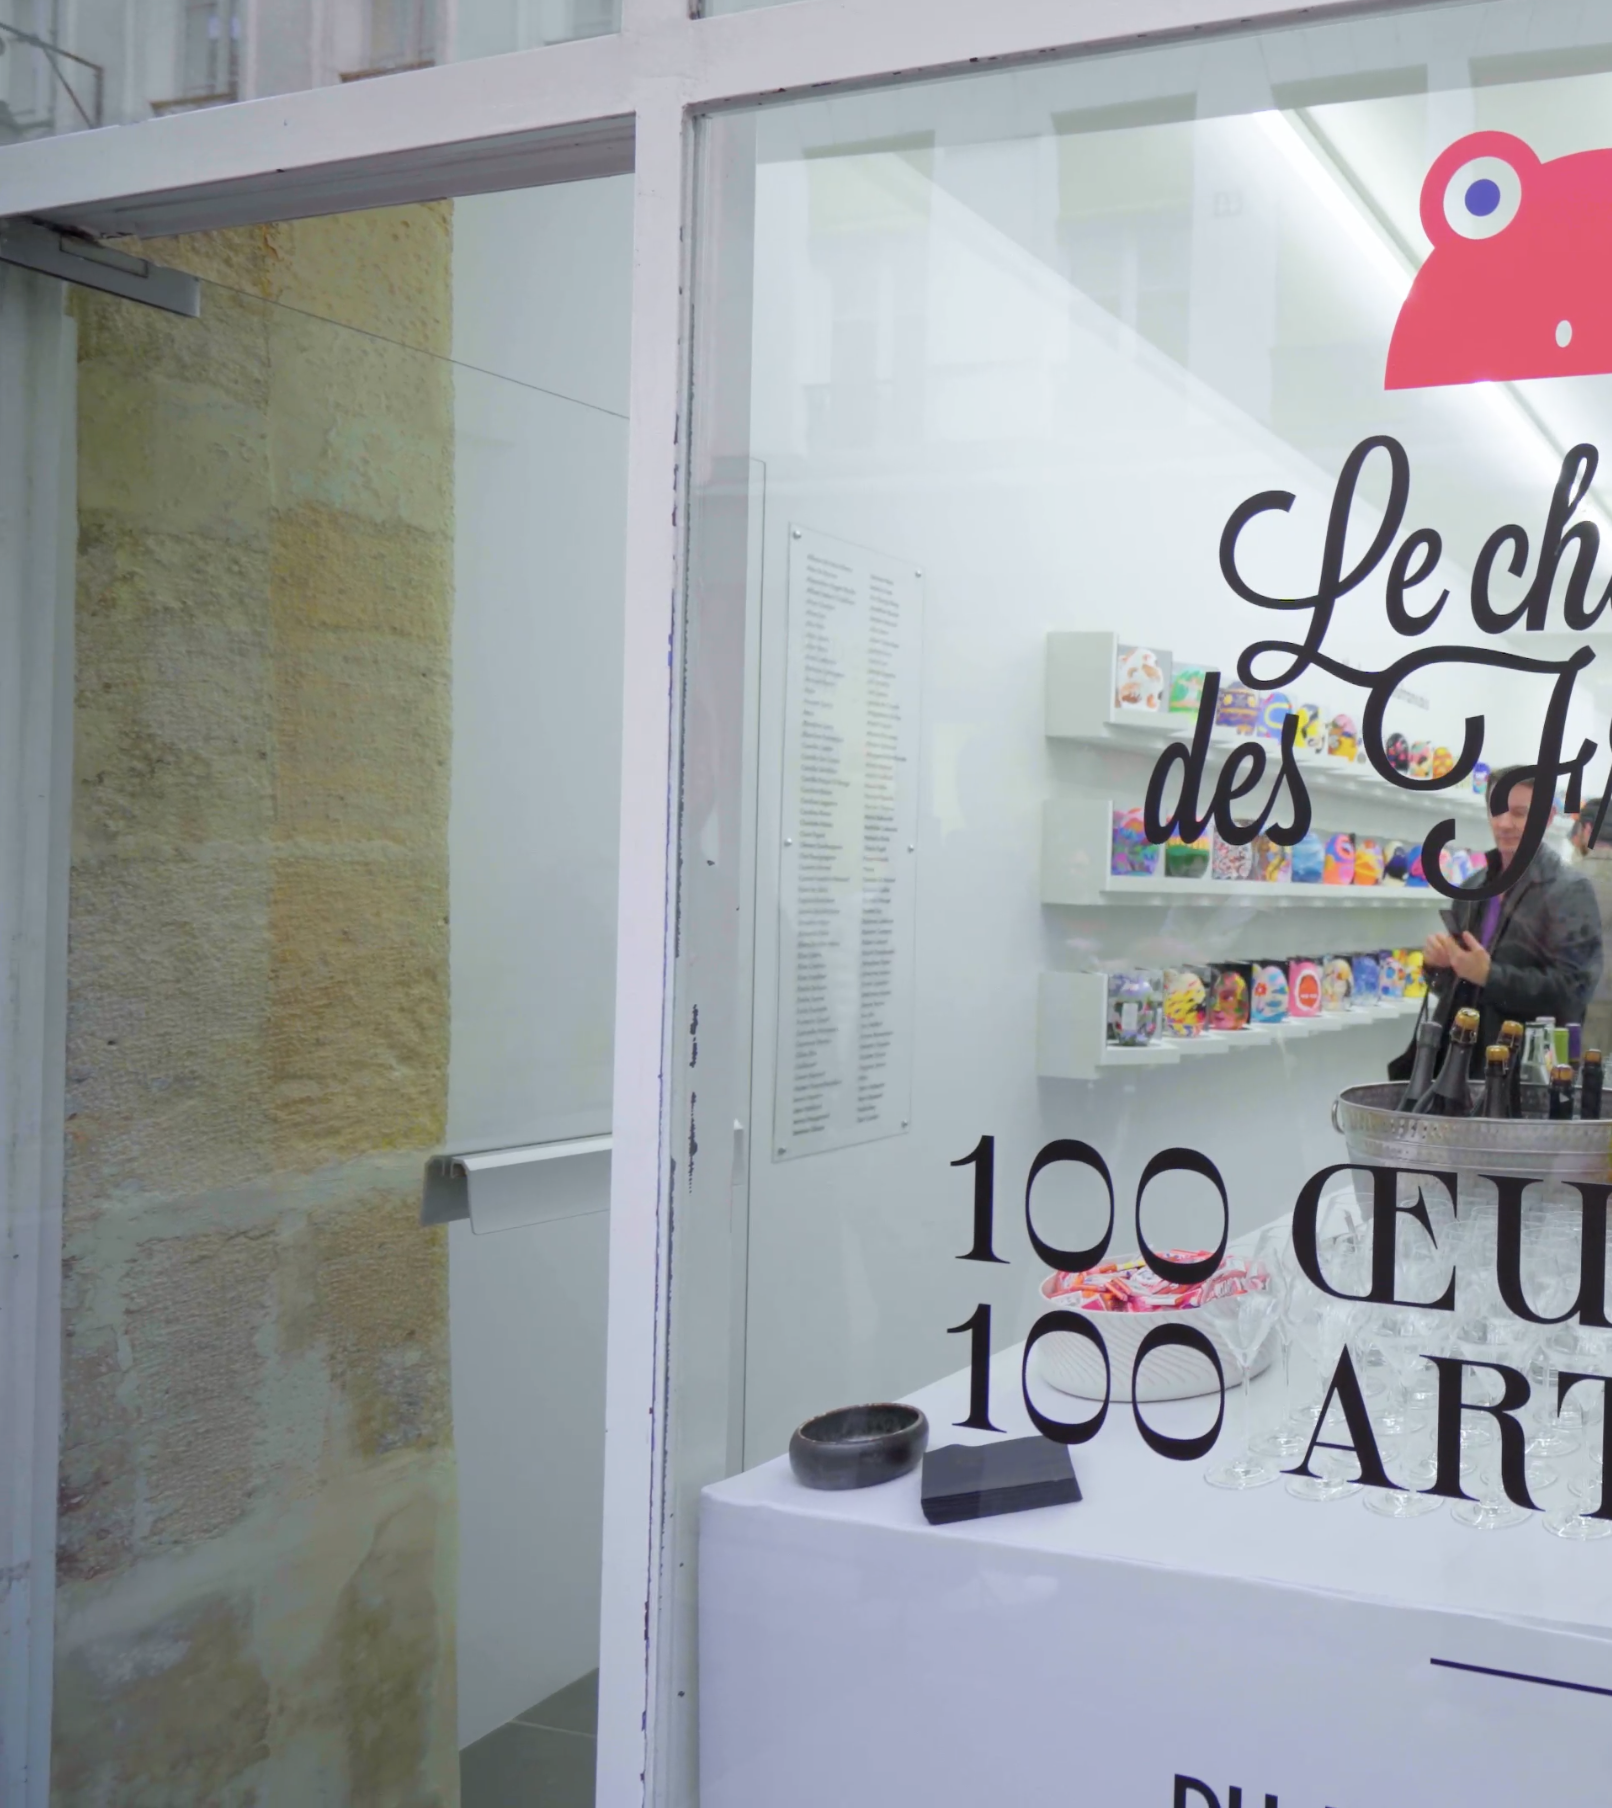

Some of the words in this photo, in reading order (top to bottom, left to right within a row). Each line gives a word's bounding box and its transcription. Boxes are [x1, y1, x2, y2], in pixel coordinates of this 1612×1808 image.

[1219, 434, 1451, 690] Le
[1143, 670, 1313, 847] des
[950, 1135, 1229, 1286] 100
[948, 1304, 1225, 1460] 100
